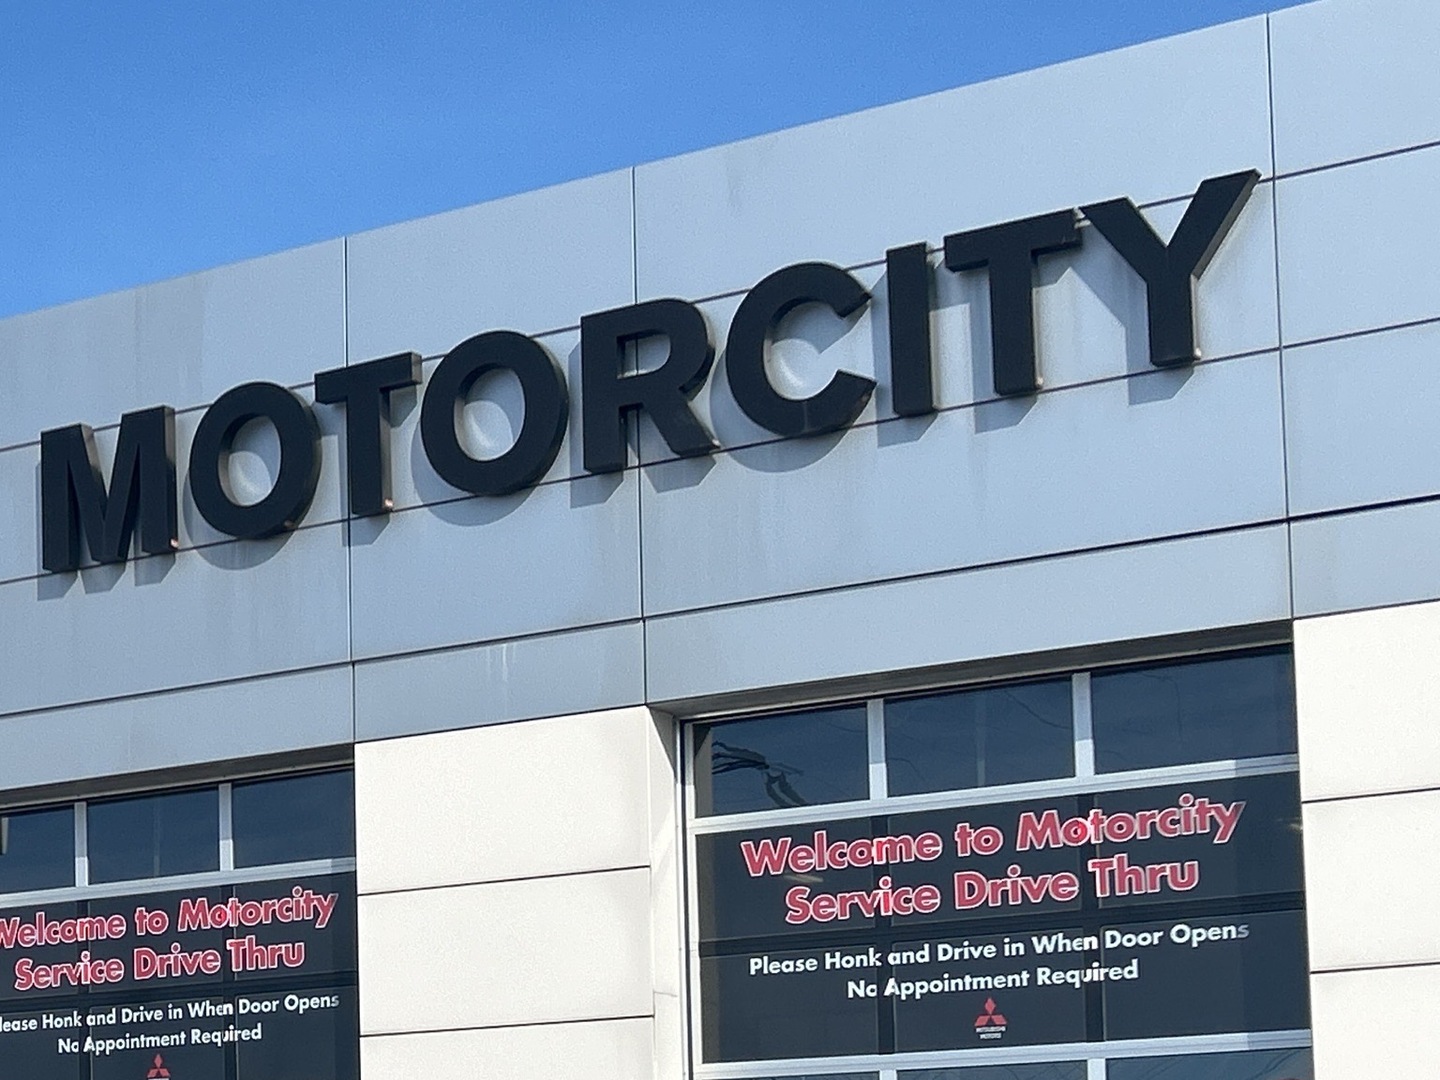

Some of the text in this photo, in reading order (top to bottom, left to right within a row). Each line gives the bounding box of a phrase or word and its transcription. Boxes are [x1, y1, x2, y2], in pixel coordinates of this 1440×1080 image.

[41, 168, 1262, 573] MOTORCITY
[740, 793, 1246, 877] Welcome to Motorcity
[135, 907, 169, 936] to
[177, 885, 339, 932] Motorcity
[785, 853, 1199, 924] Service Drive Thru
[14, 935, 305, 991] Service Drive Thru
[749, 923, 1250, 975] Please Honk and Drive in When Door Opens
[847, 958, 1139, 1000] No Appointment Required
[42, 1011, 82, 1029] Honk
[86, 1008, 116, 1026] and
[122, 1006, 163, 1023] Drive
[168, 1004, 183, 1020] in
[187, 1000, 233, 1018] When
[239, 999, 280, 1014] Door
[284, 994, 339, 1014] Opens
[58, 1023, 262, 1056] No Appointment Required
